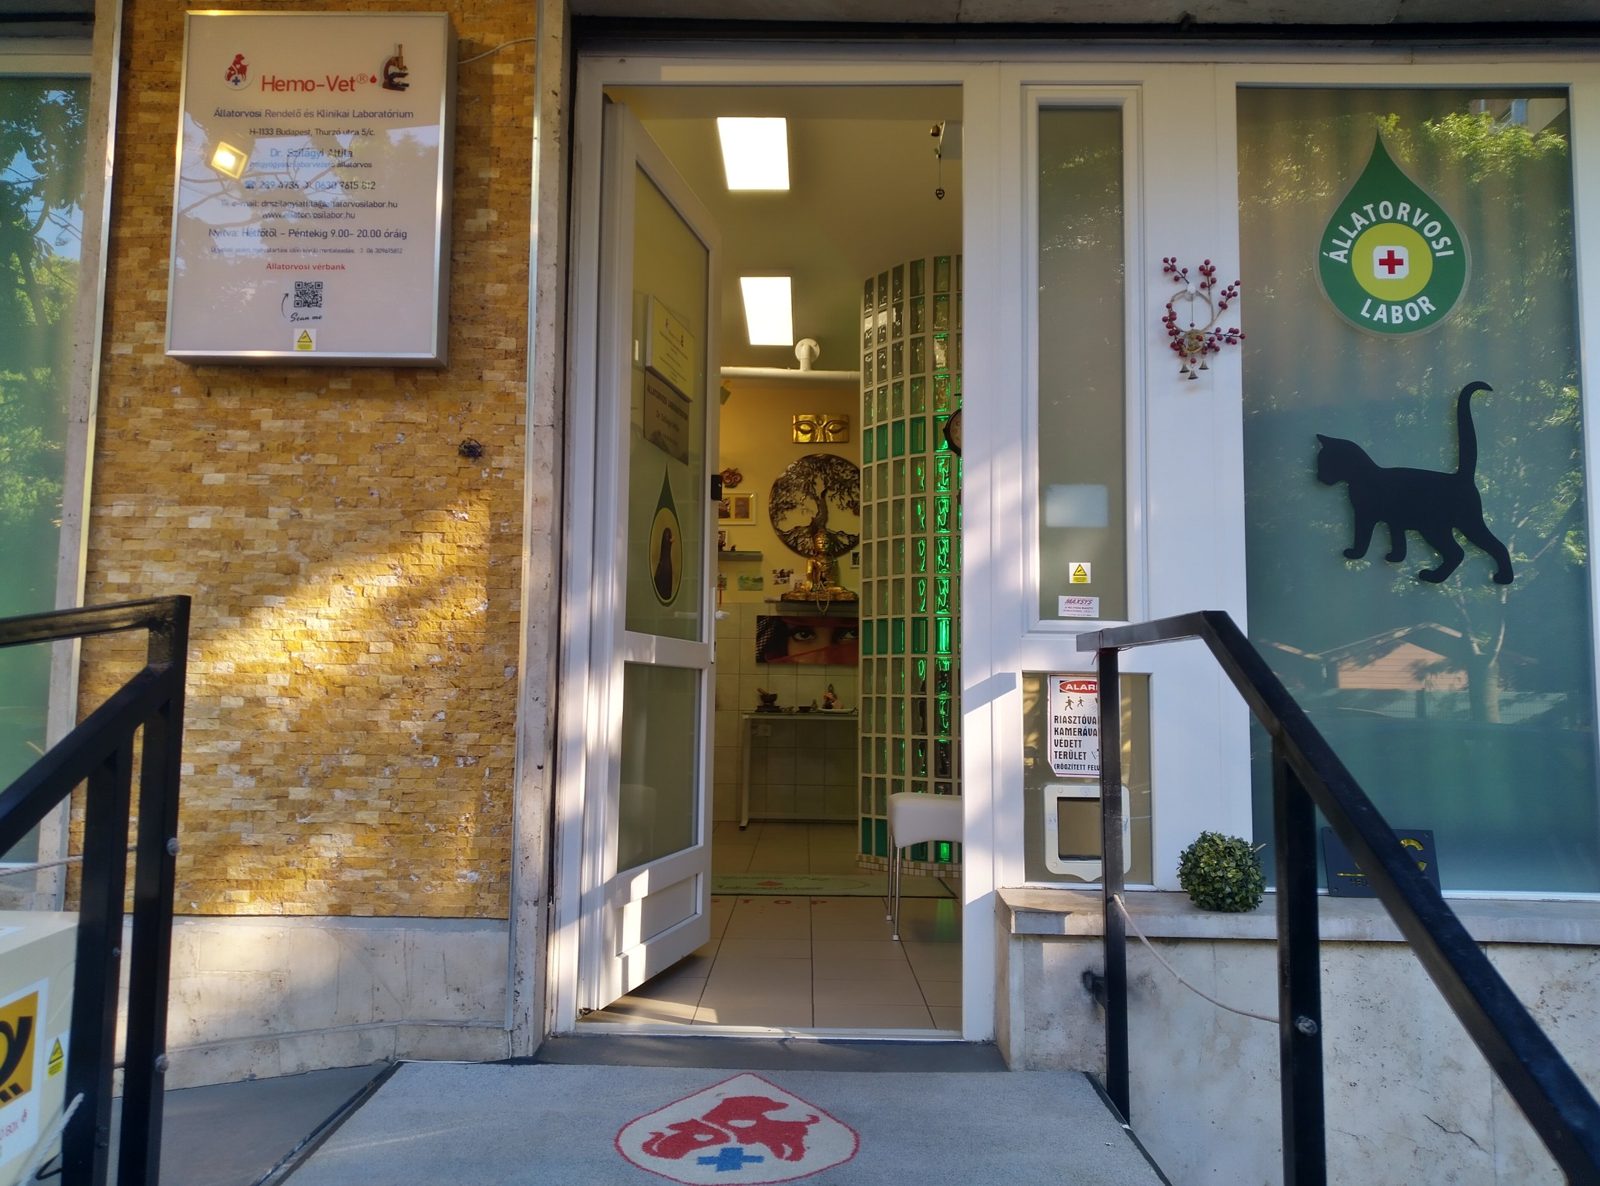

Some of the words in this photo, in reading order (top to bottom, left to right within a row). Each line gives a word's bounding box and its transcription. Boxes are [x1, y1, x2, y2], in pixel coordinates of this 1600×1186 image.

[213, 107, 262, 118] Állatorvosi
[264, 108, 302, 118] Rendelő
[317, 109, 350, 118] Klinikai
[352, 108, 414, 118] Laboratórium
[288, 228, 328, 239] Péntekig
[356, 229, 382, 238] 20.00
[383, 228, 408, 240] óráig
[1323, 200, 1455, 264] ÁLLATORVOSI
[1360, 295, 1437, 324] LABOR
[1053, 714, 1098, 725] RIASZTÓVA
[1053, 726, 1099, 737] KAMERÁVA
[1053, 738, 1082, 748] VÉDETT
[1053, 750, 1087, 760] TERÜLET
